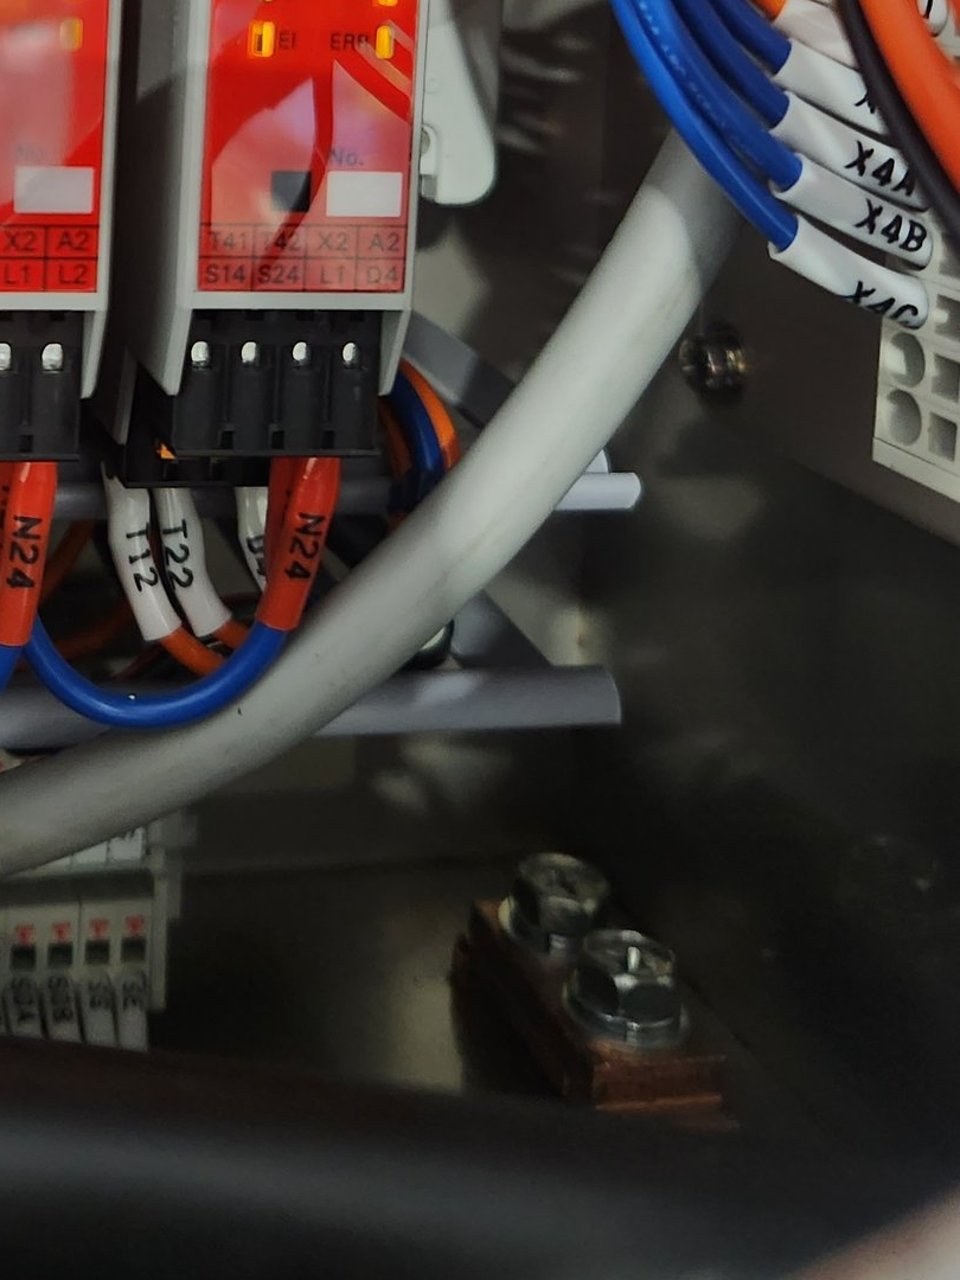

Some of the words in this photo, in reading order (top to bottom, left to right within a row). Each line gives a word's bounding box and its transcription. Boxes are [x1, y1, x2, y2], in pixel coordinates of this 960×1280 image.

[3, 230, 36, 252] X2
[57, 230, 91, 251] A2
[317, 232, 349, 252] X2
[367, 233, 401, 252] A2
[853, 197, 928, 253] X4B
[3, 263, 31, 285] L1
[58, 263, 90, 286] L2
[205, 264, 247, 285] S14
[257, 264, 300, 285] S24
[365, 266, 399, 285] D4
[5, 515, 44, 591] N24
[125, 522, 159, 593] T12
[163, 519, 194, 591] T22
[282, 512, 326, 581] N24
